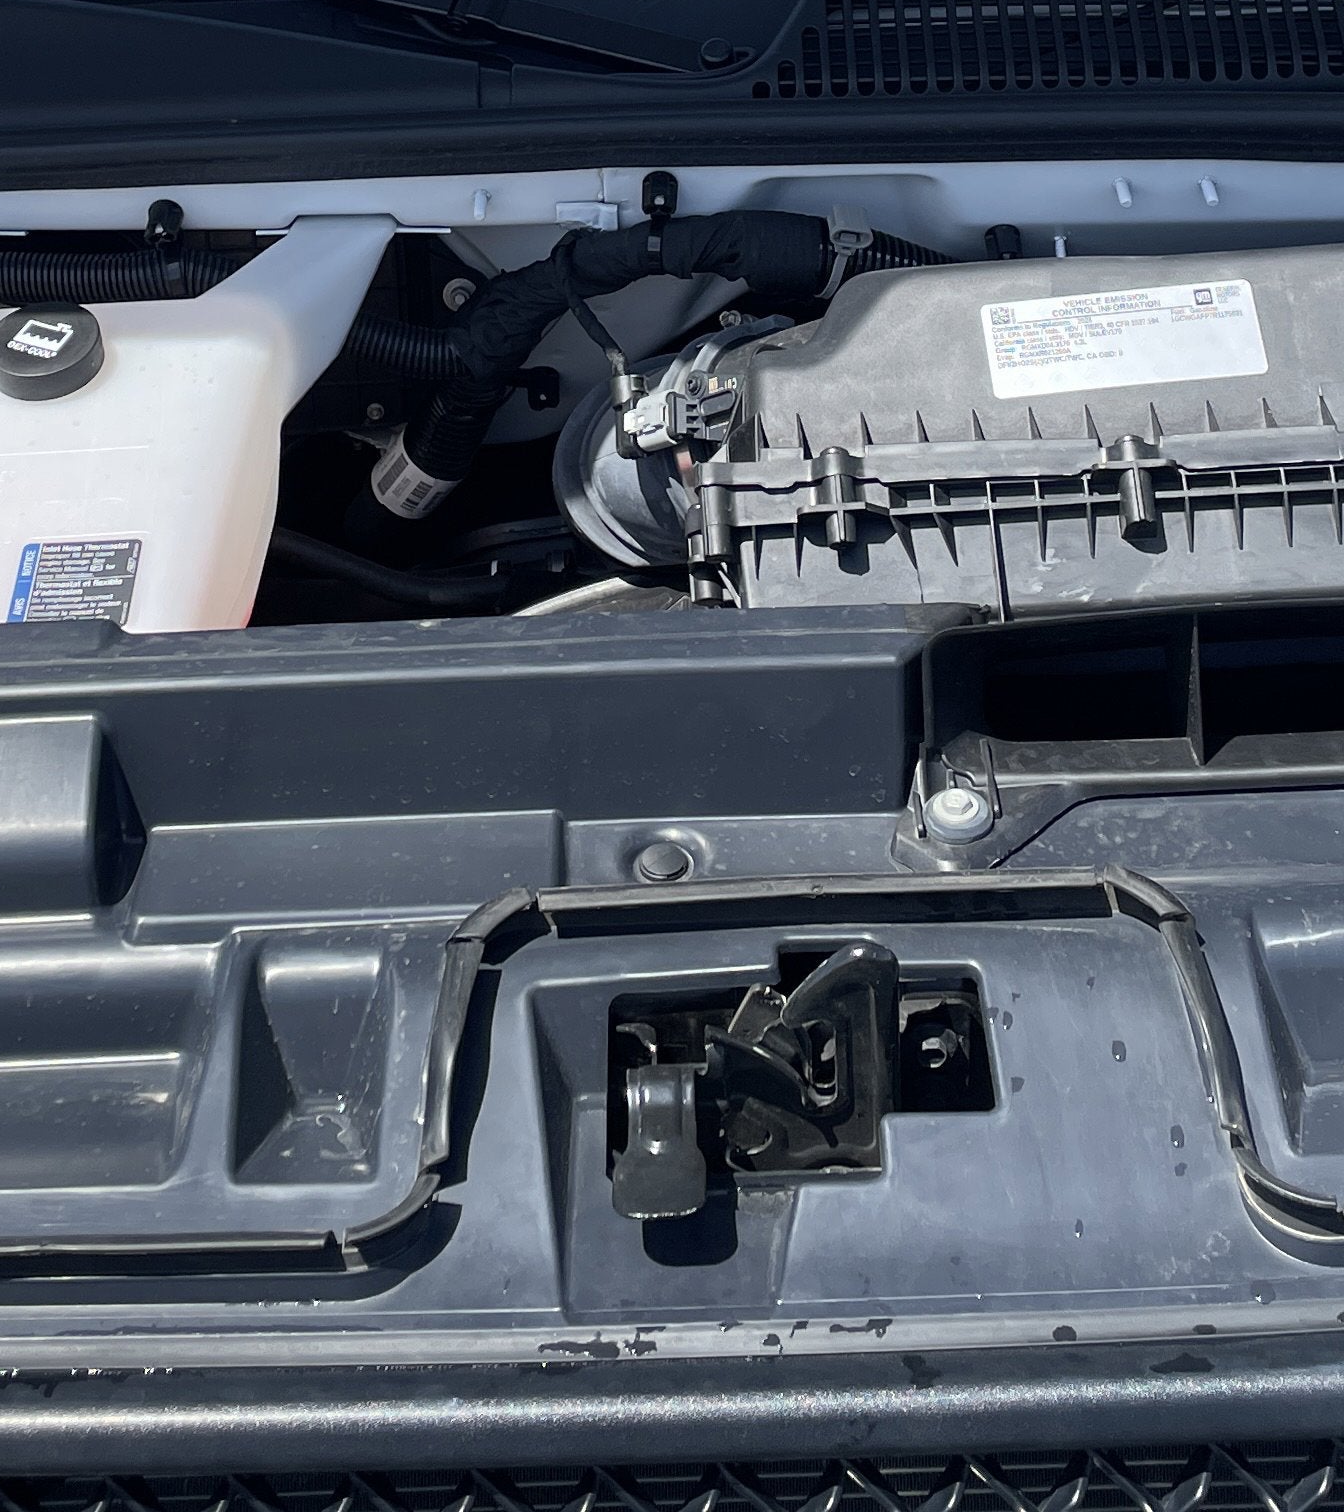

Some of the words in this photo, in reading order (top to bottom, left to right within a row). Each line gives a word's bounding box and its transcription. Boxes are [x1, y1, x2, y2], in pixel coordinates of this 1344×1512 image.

[1052, 306, 1097, 318] CONTROL
[1098, 300, 1161, 313] INFORMATION
[1063, 297, 1101, 308] VEHICLE
[1104, 293, 1148, 304] EMISSION
[83, 542, 130, 551] Thermostat
[21, 550, 36, 577] NOTICE
[13, 597, 26, 616] AVIS
